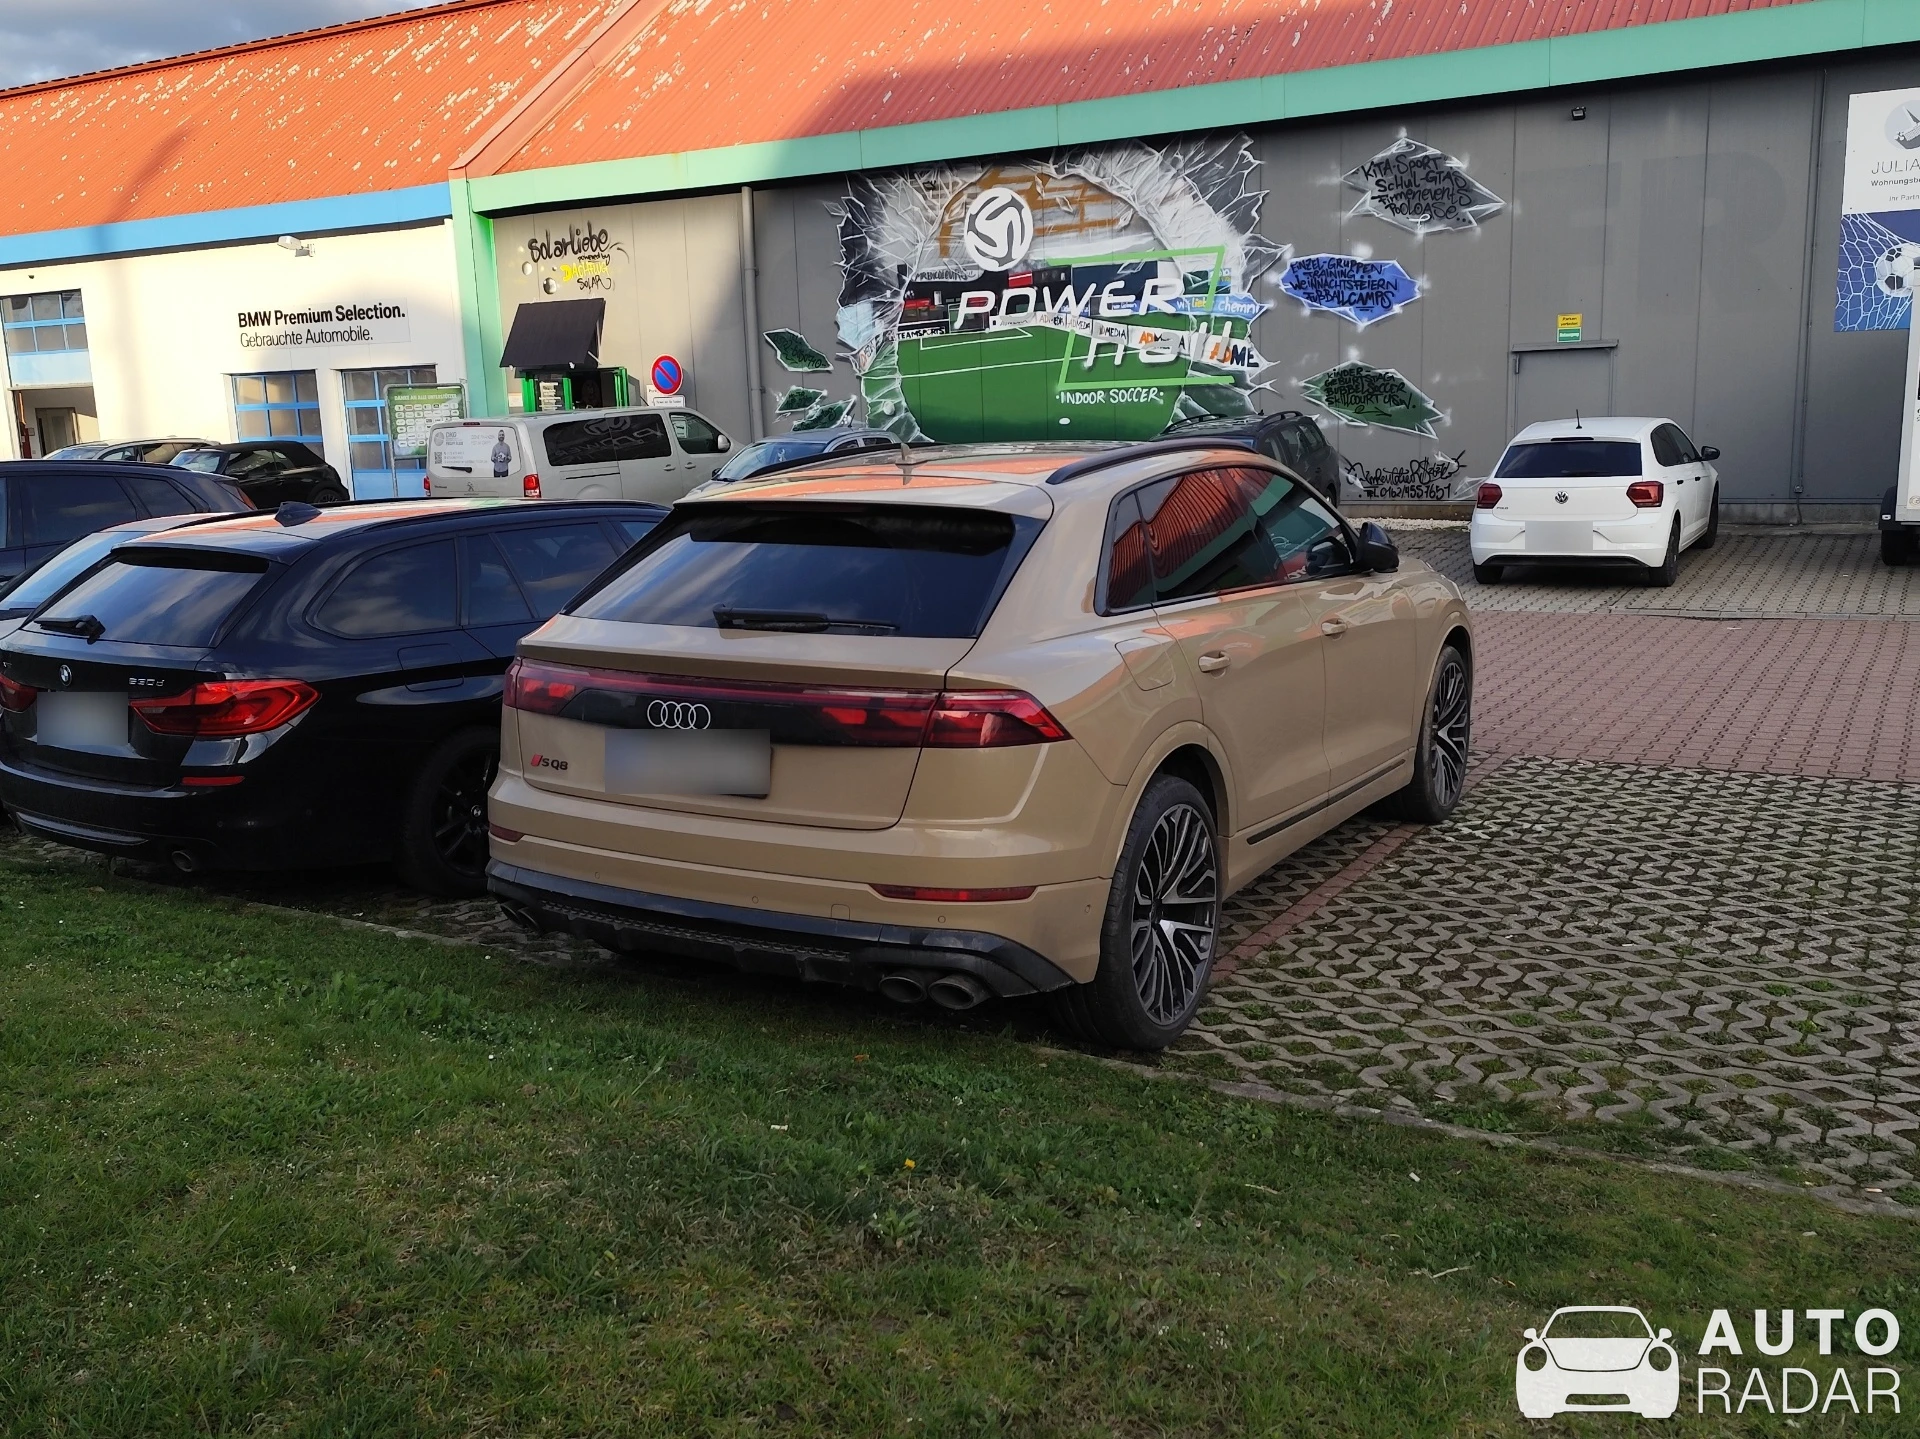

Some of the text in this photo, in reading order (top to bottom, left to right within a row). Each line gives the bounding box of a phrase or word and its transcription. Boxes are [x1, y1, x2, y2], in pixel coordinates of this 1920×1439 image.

[527, 220, 610, 263] Solarliebe
[1303, 268, 1356, 280] TRAINING
[953, 278, 1184, 330] POWER
[238, 302, 406, 328] BMW Premium Selection.
[240, 326, 373, 347] Gebrauchte Automobile.
[1060, 387, 1160, 404] INDOOR SOCCER
[541, 757, 569, 771] SQ8
